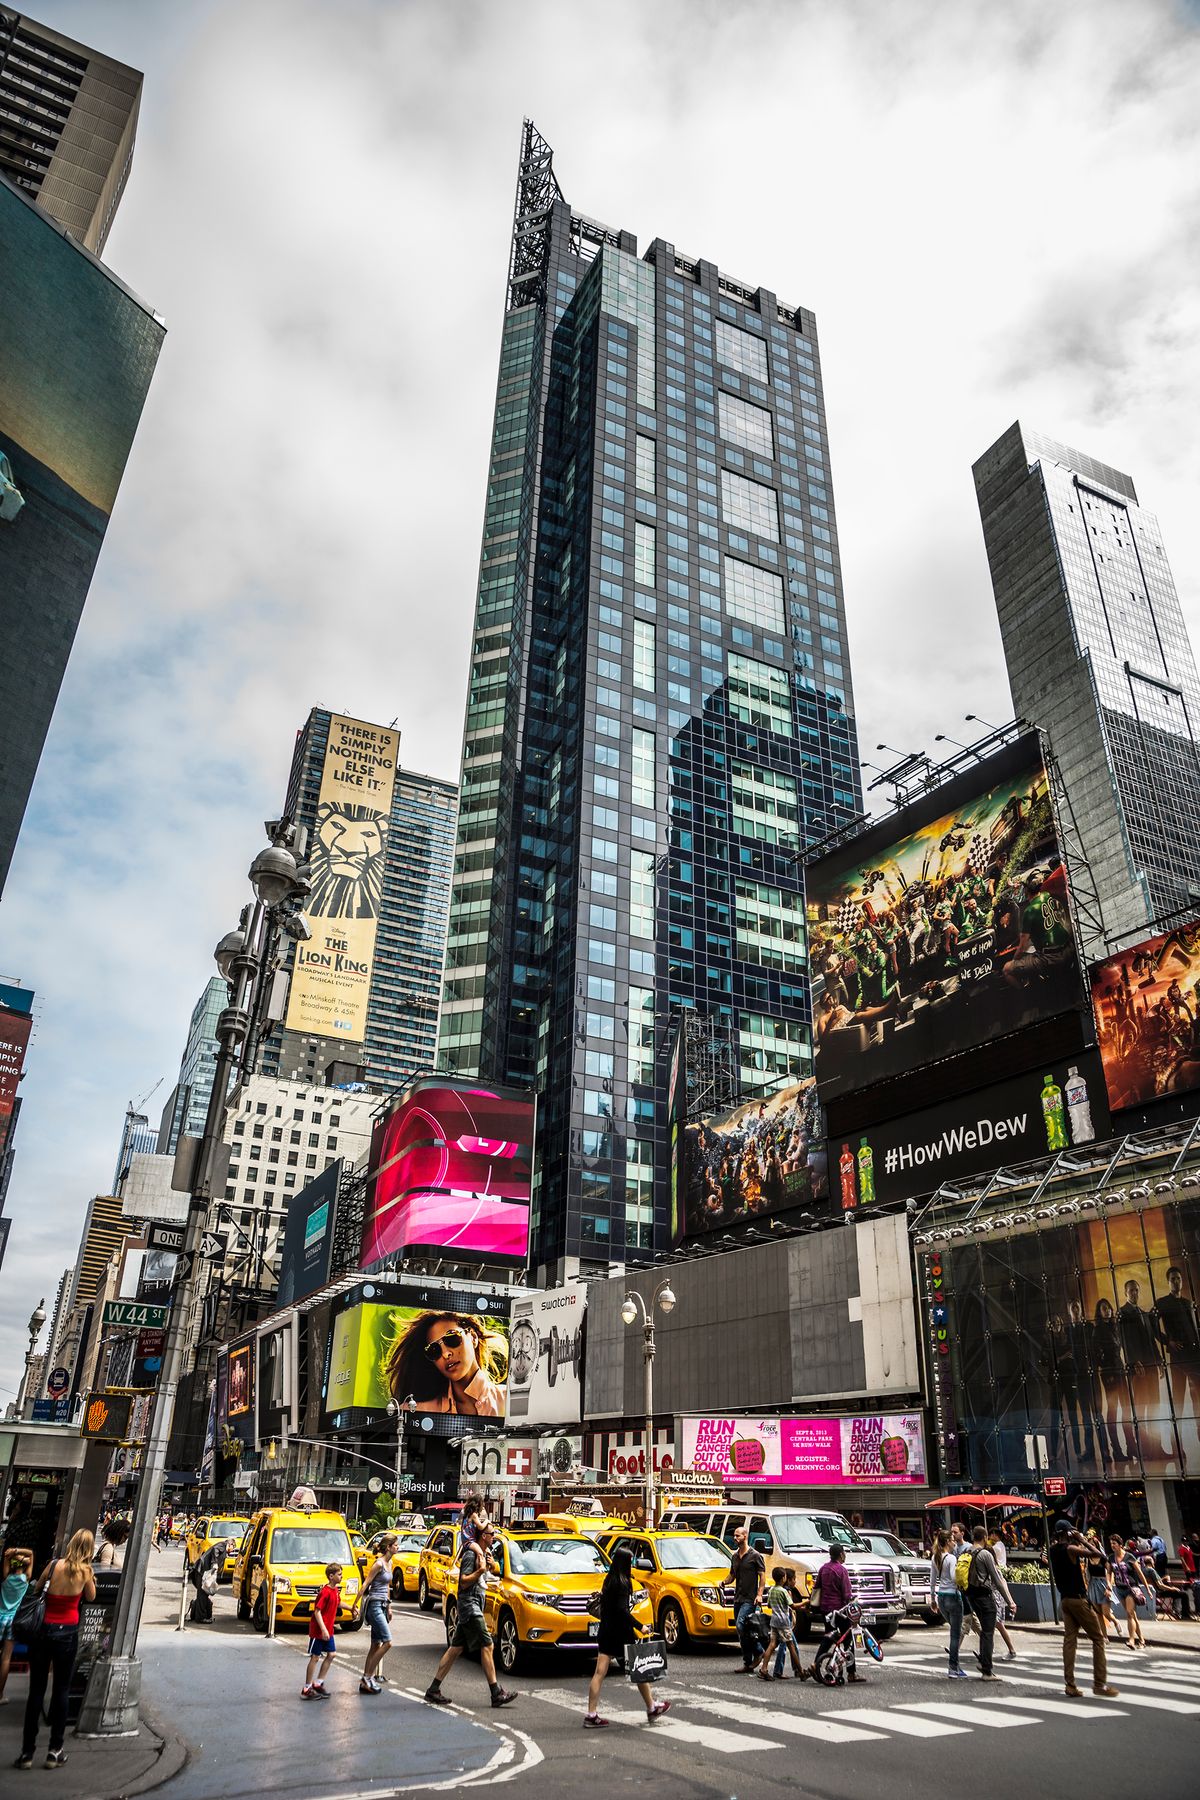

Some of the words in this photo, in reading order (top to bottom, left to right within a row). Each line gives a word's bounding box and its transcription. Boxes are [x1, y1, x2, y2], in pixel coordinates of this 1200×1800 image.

[340, 735, 386, 755] SIMPLY
[380, 734, 391, 745] IS
[329, 744, 393, 769] NOTHING
[344, 760, 375, 777] ELSE
[333, 769, 364, 786] LIKE
[325, 937, 348, 951] THE
[959, 949, 970, 961] THIS
[971, 946, 977, 956] IS
[978, 935, 993, 953] HOW
[960, 969, 971, 980] WE
[973, 957, 993, 979] DEW
[309, 976, 334, 985] MUSICAL
[335, 980, 354, 988] EVENT
[334, 973, 367, 984] LANDMARK
[300, 1000, 332, 1013] Broadway
[341, 1008, 356, 1017] 45th
[14, 1045, 23, 1053] IS
[0, 1053, 17, 1063] PLY
[884, 1113, 1028, 1175] #HowWeDew
[160, 1231, 184, 1246] ONE
[200, 1240, 216, 1252] AY
[541, 1296, 571, 1311] swatch
[108, 1303, 125, 1322] W
[126, 1306, 148, 1325] 44
[152, 1308, 162, 1319] St
[698, 1420, 736, 1434] RUN
[852, 1417, 884, 1434] RUN
[696, 1434, 733, 1444] BREAST
[851, 1433, 883, 1444] BREAST
[695, 1444, 731, 1452] CANCER
[850, 1444, 882, 1452] CANCER
[608, 1449, 646, 1475] Foot
[694, 1453, 715, 1461] OUT
[716, 1453, 731, 1461] OF
[849, 1453, 869, 1462] OUT
[869, 1453, 881, 1462] OF
[693, 1462, 729, 1473] TOWN
[848, 1462, 880, 1474] TOWN
[671, 1470, 715, 1485] nuchas
[384, 1481, 427, 1494] suglass
[428, 1480, 446, 1493] hut
[85, 1608, 107, 1616] START
[85, 1617, 104, 1625] YOUR
[83, 1625, 101, 1633] VISIT
